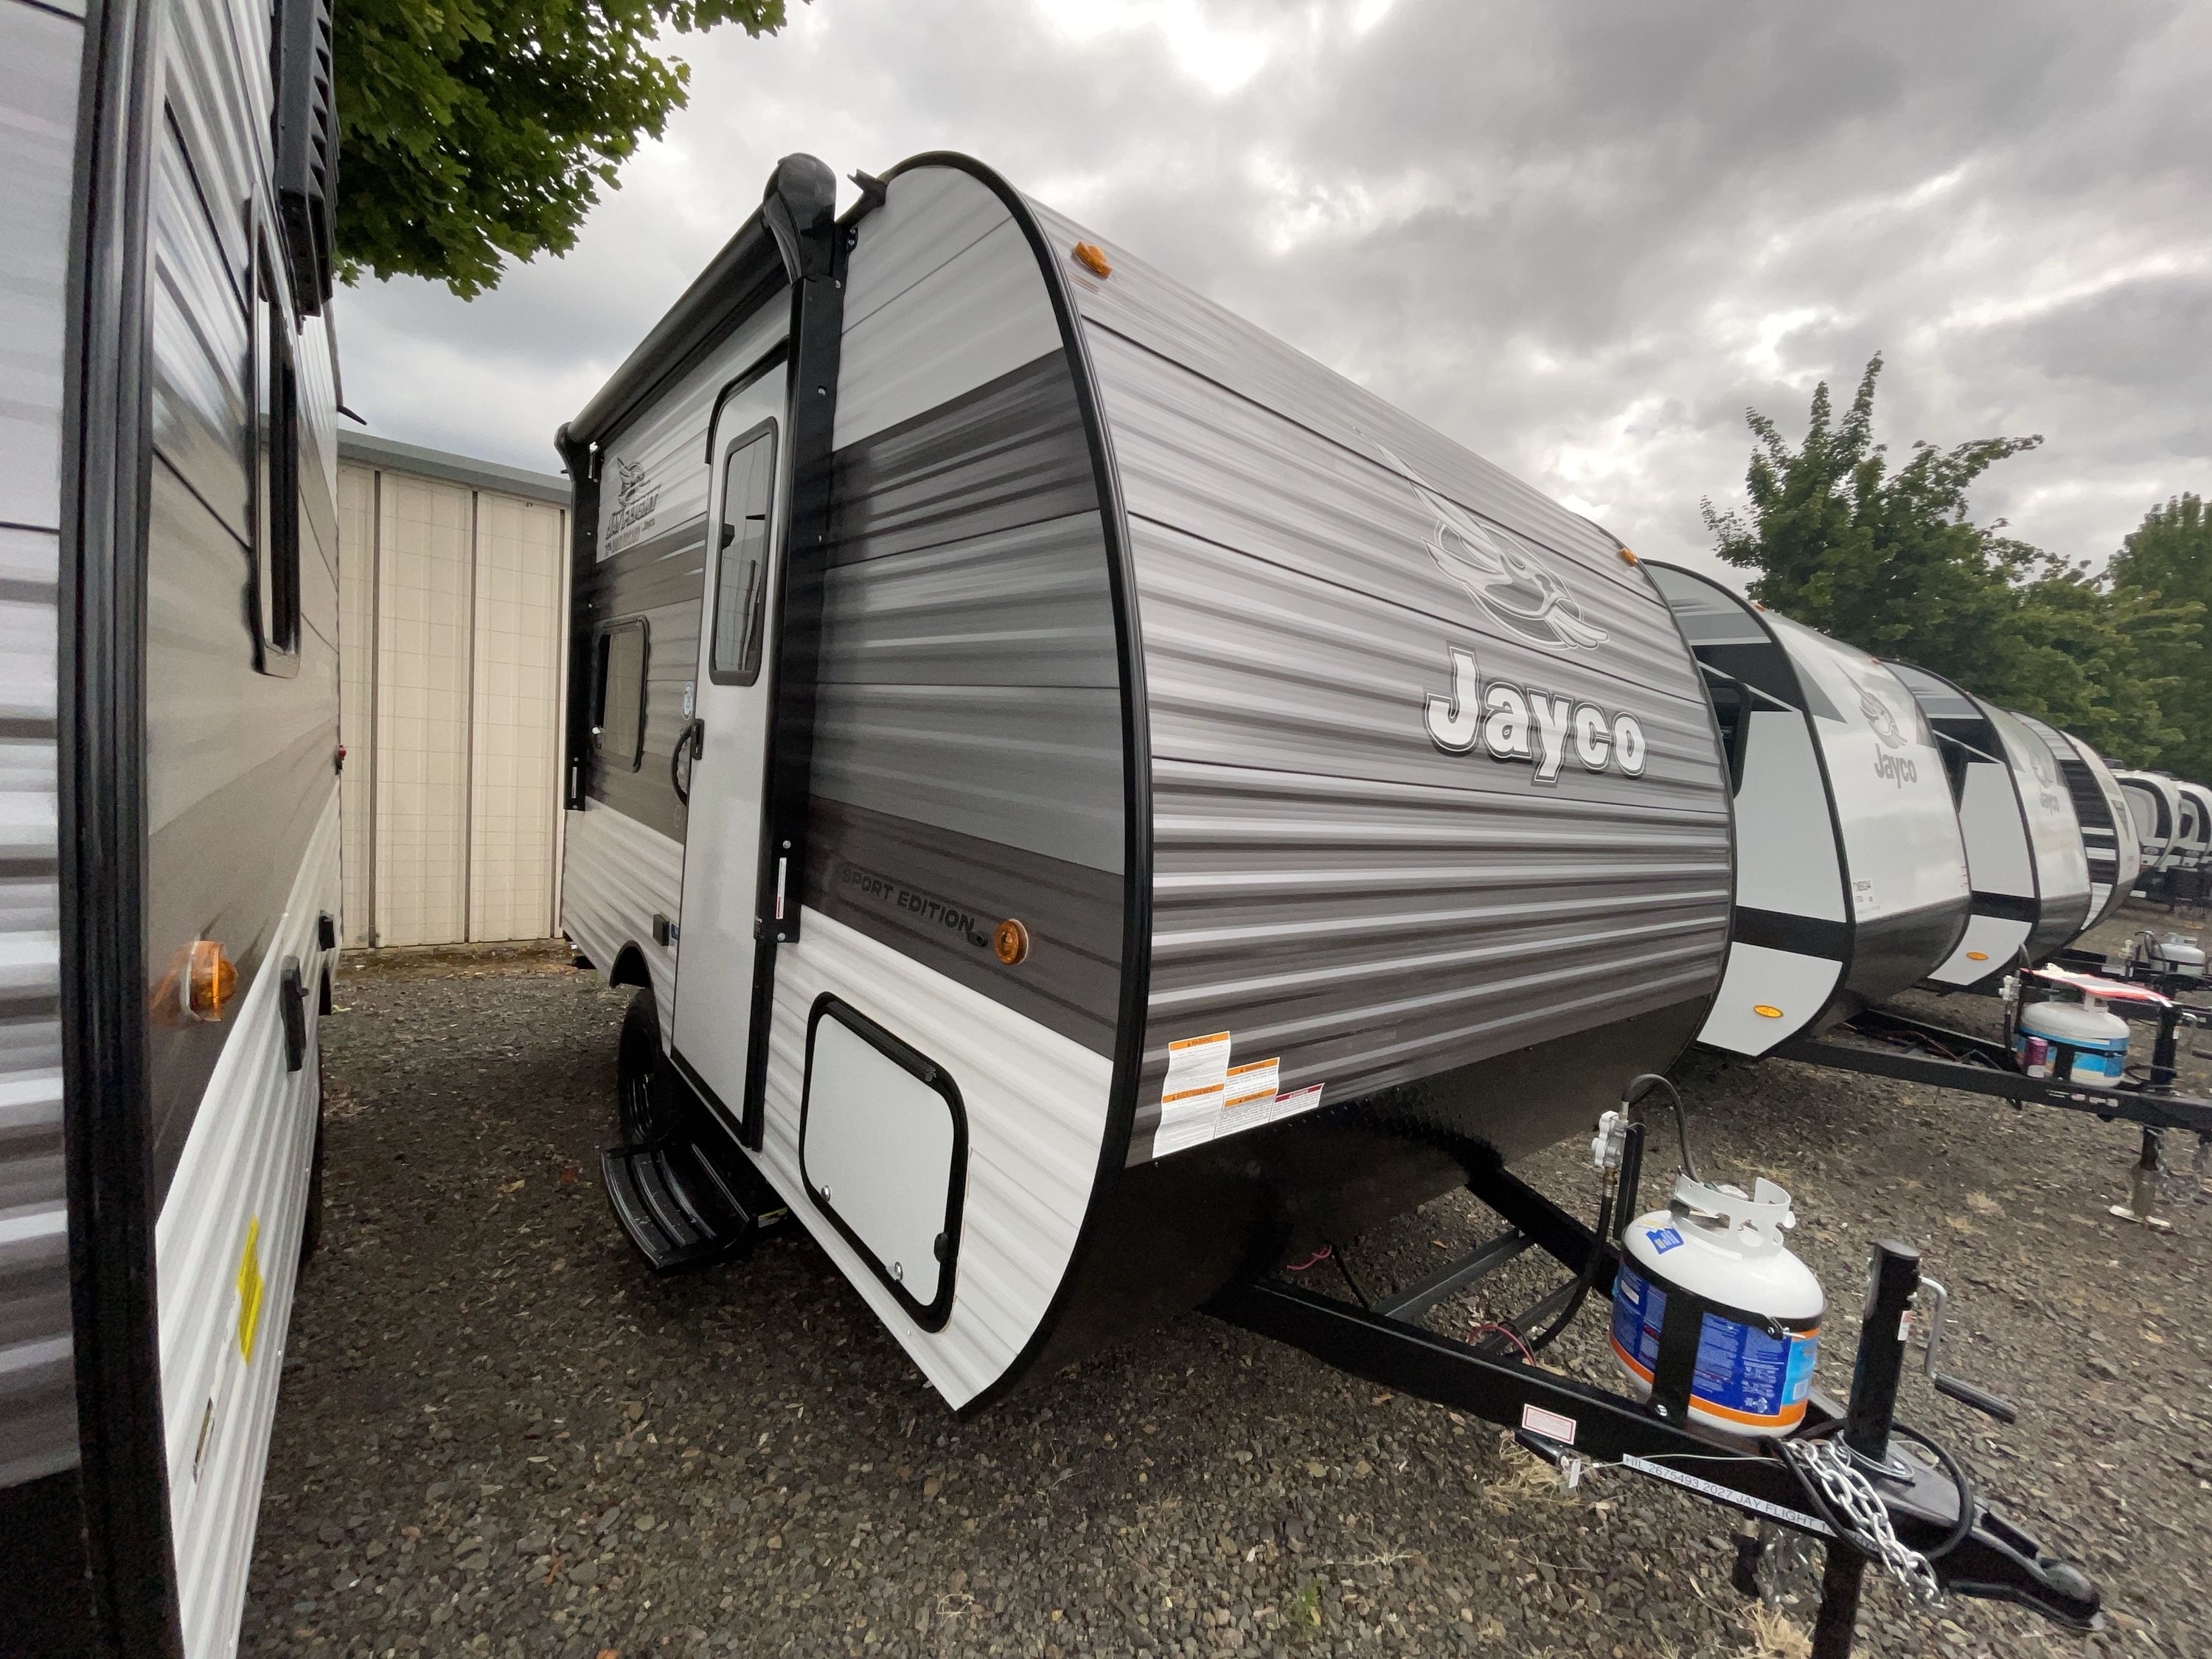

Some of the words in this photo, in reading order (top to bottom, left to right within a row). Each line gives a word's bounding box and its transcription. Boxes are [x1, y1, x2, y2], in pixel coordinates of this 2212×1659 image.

[1422, 641, 1648, 787] Jayco
[1874, 742, 1917, 790] Jayco
[841, 867, 894, 900] SPORT
[897, 890, 975, 934] EDITION
[1626, 1455, 1646, 1470] HIL
[1648, 1463, 1700, 1488] 2675493
[1703, 1482, 1733, 1499] 2027
[1736, 1492, 1761, 1510] JAY
[1765, 1503, 1818, 1528] FLIGHT
